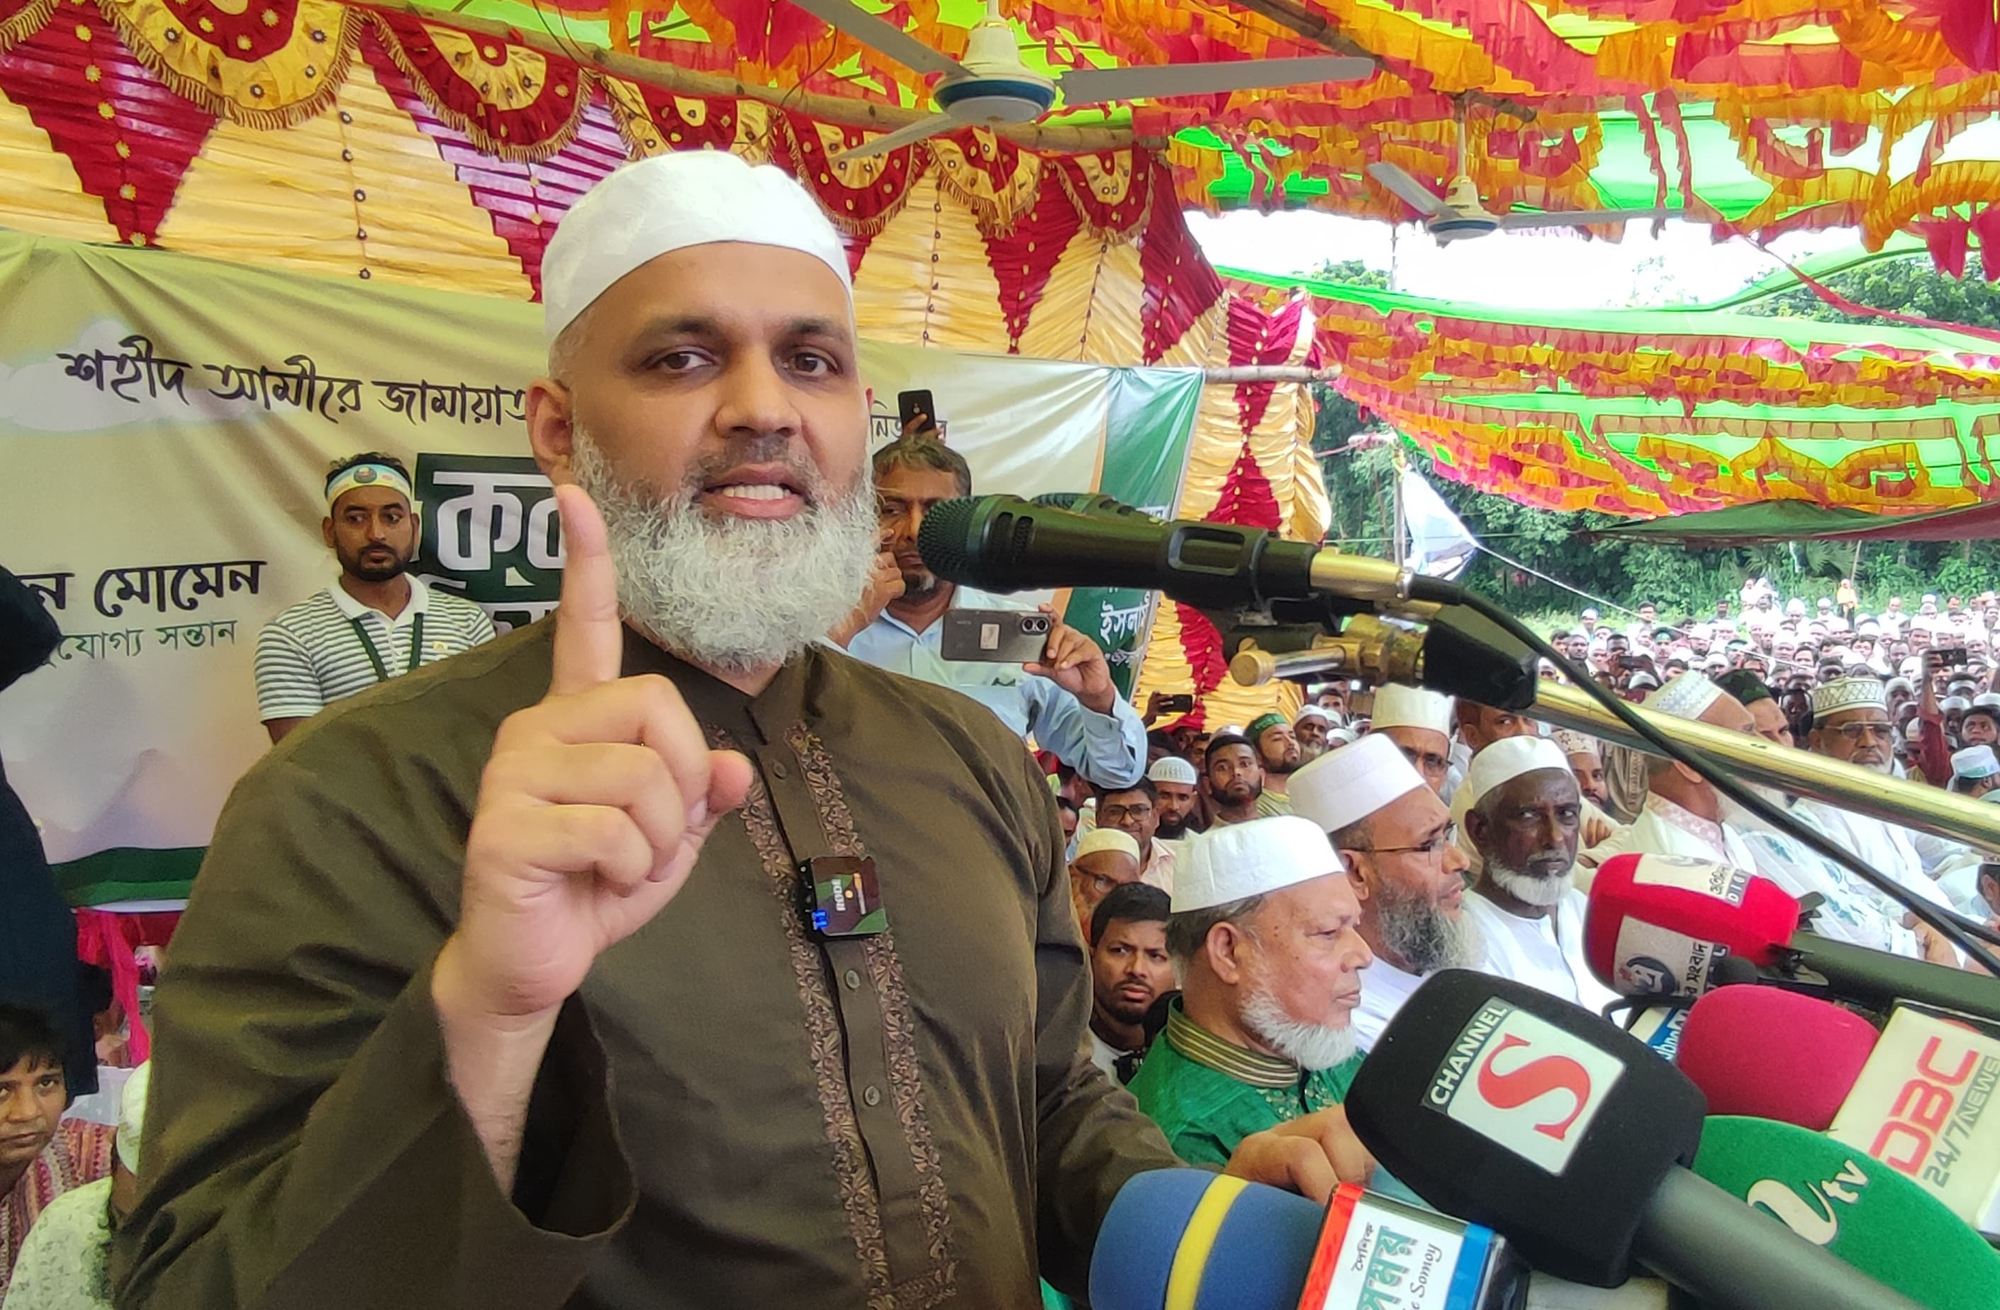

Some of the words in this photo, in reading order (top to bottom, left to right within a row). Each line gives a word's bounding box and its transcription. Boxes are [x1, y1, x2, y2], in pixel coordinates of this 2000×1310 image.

[55, 335, 193, 405] শহীদ
[202, 354, 363, 424] আমীরে
[94, 561, 268, 618] মোমেন
[47, 628, 144, 669] যোগ্য
[155, 620, 238, 650] সন্তান
[1430, 1005, 1508, 1105] CHANNEL
[1478, 1033, 1591, 1141] S
[1868, 1036, 1979, 1177] DBC
[1409, 1243, 1443, 1299] Somoy
